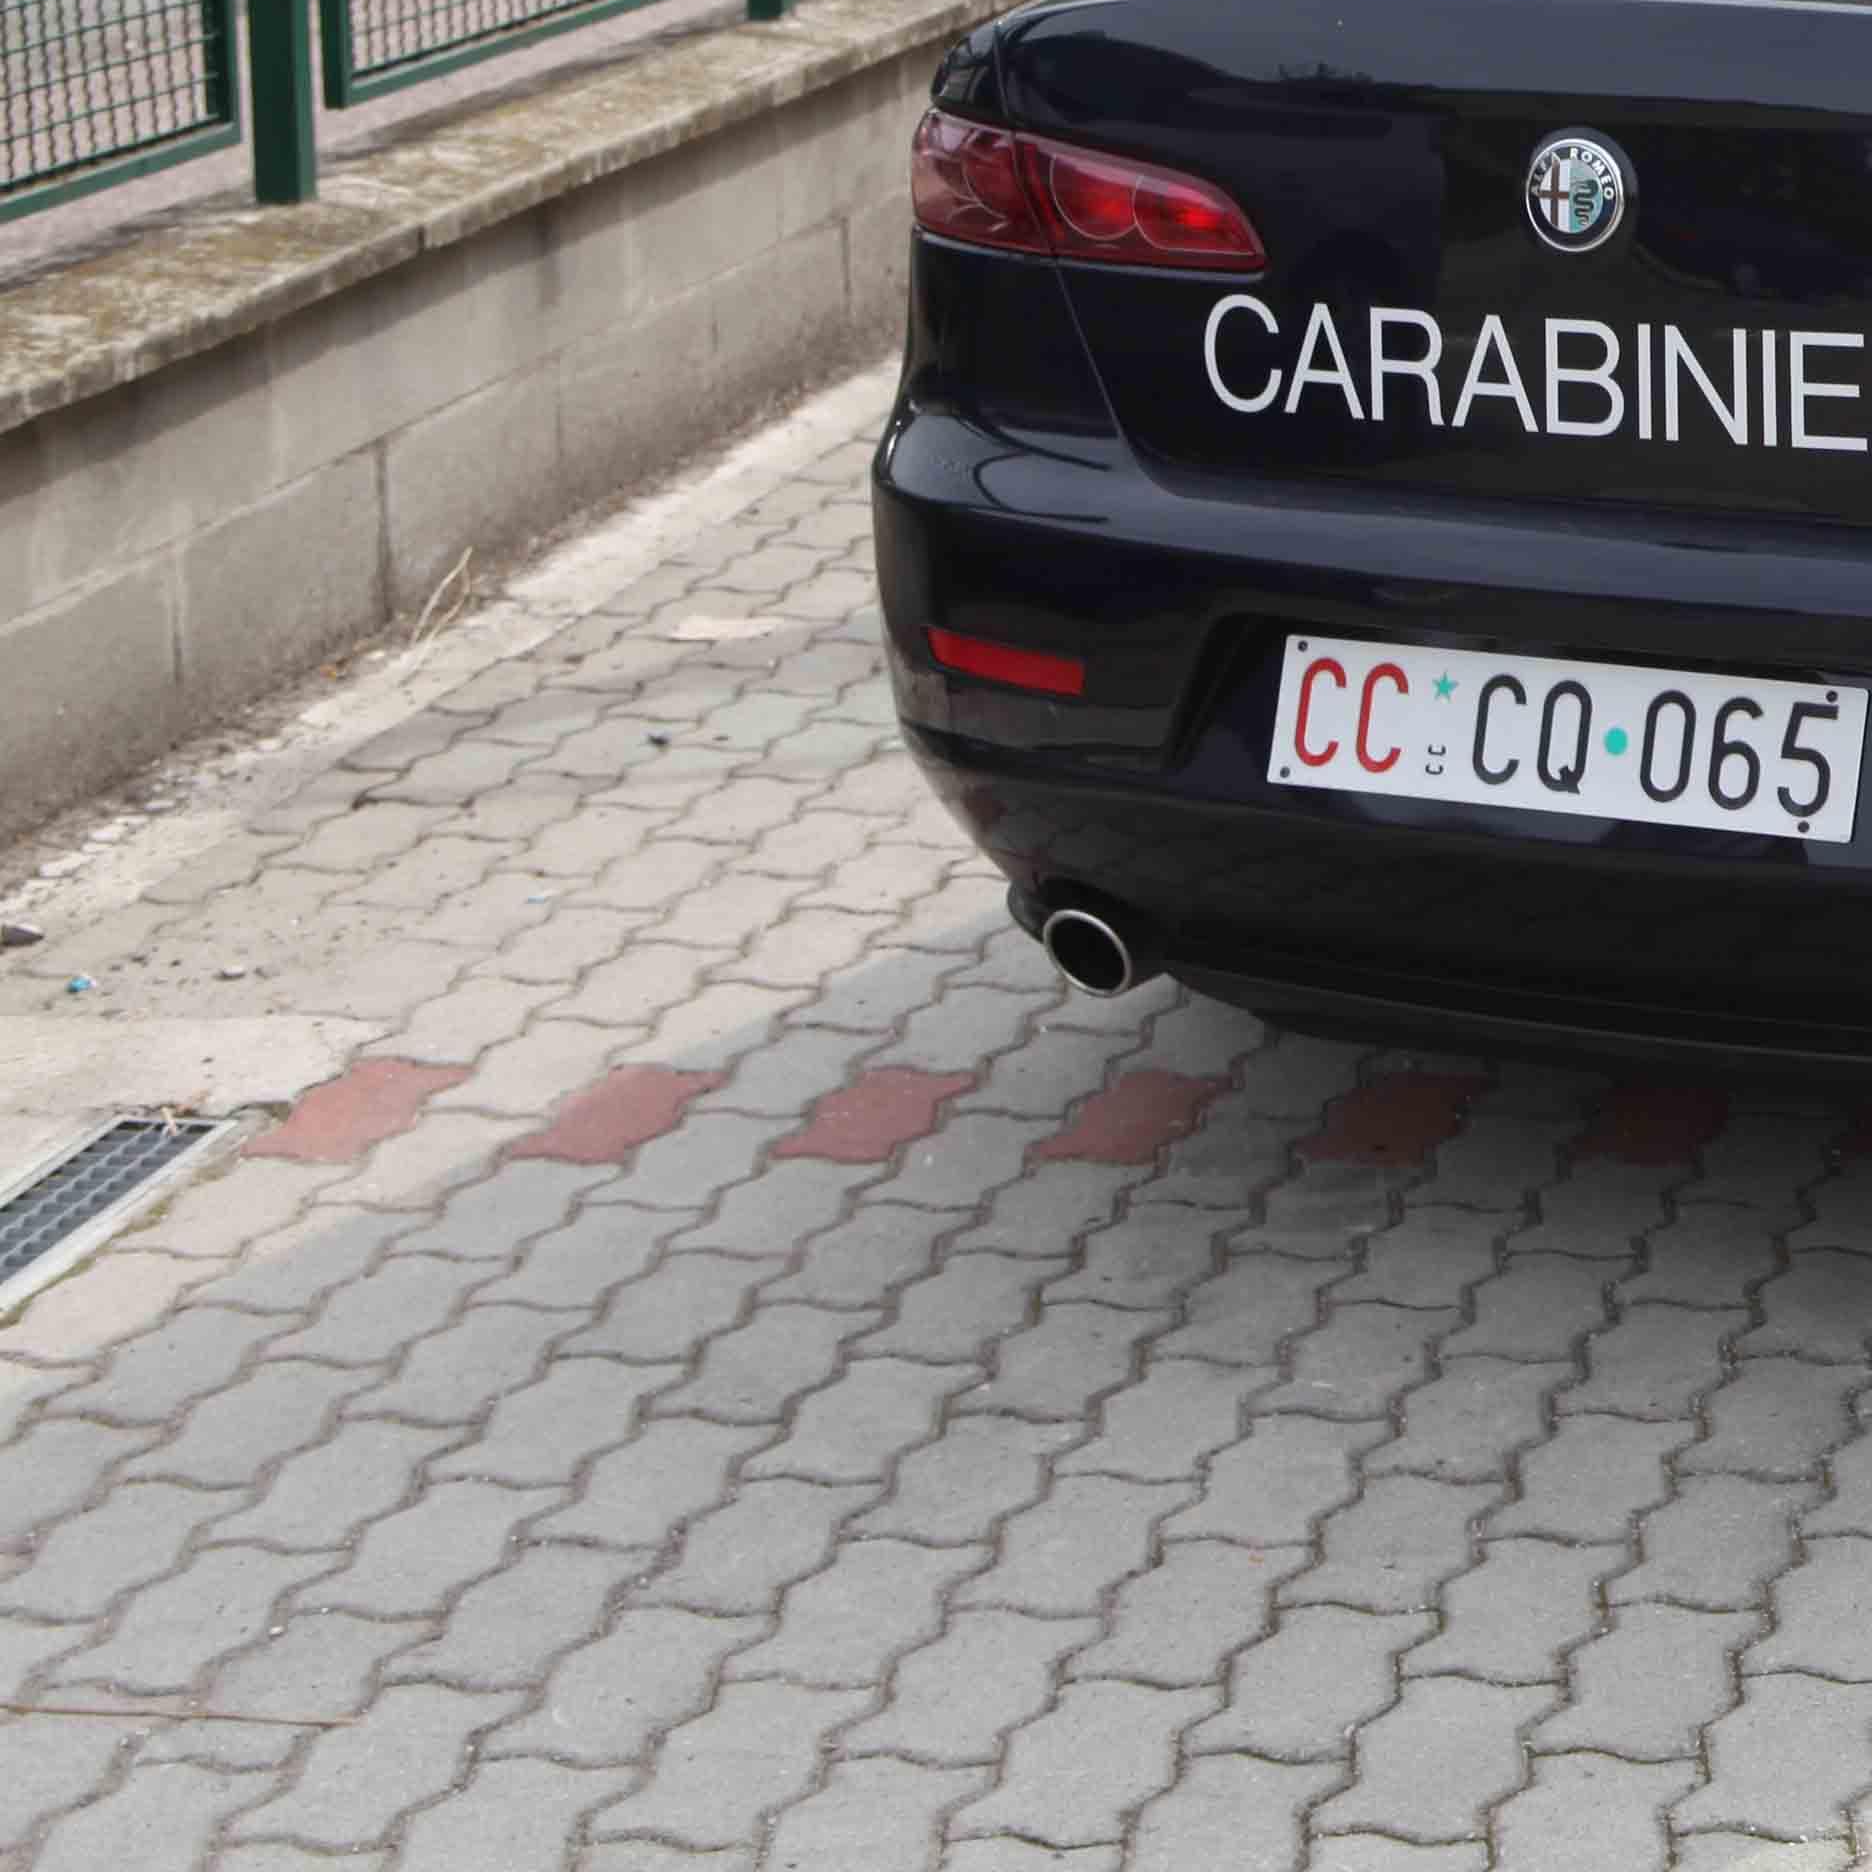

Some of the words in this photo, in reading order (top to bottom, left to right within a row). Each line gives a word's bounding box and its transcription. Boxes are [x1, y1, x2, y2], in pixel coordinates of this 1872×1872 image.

[1569, 147, 1615, 200] ROMEO
[1294, 657, 1410, 774] CC
[1472, 673, 1593, 795] CQ
[1639, 689, 1840, 818] 065
